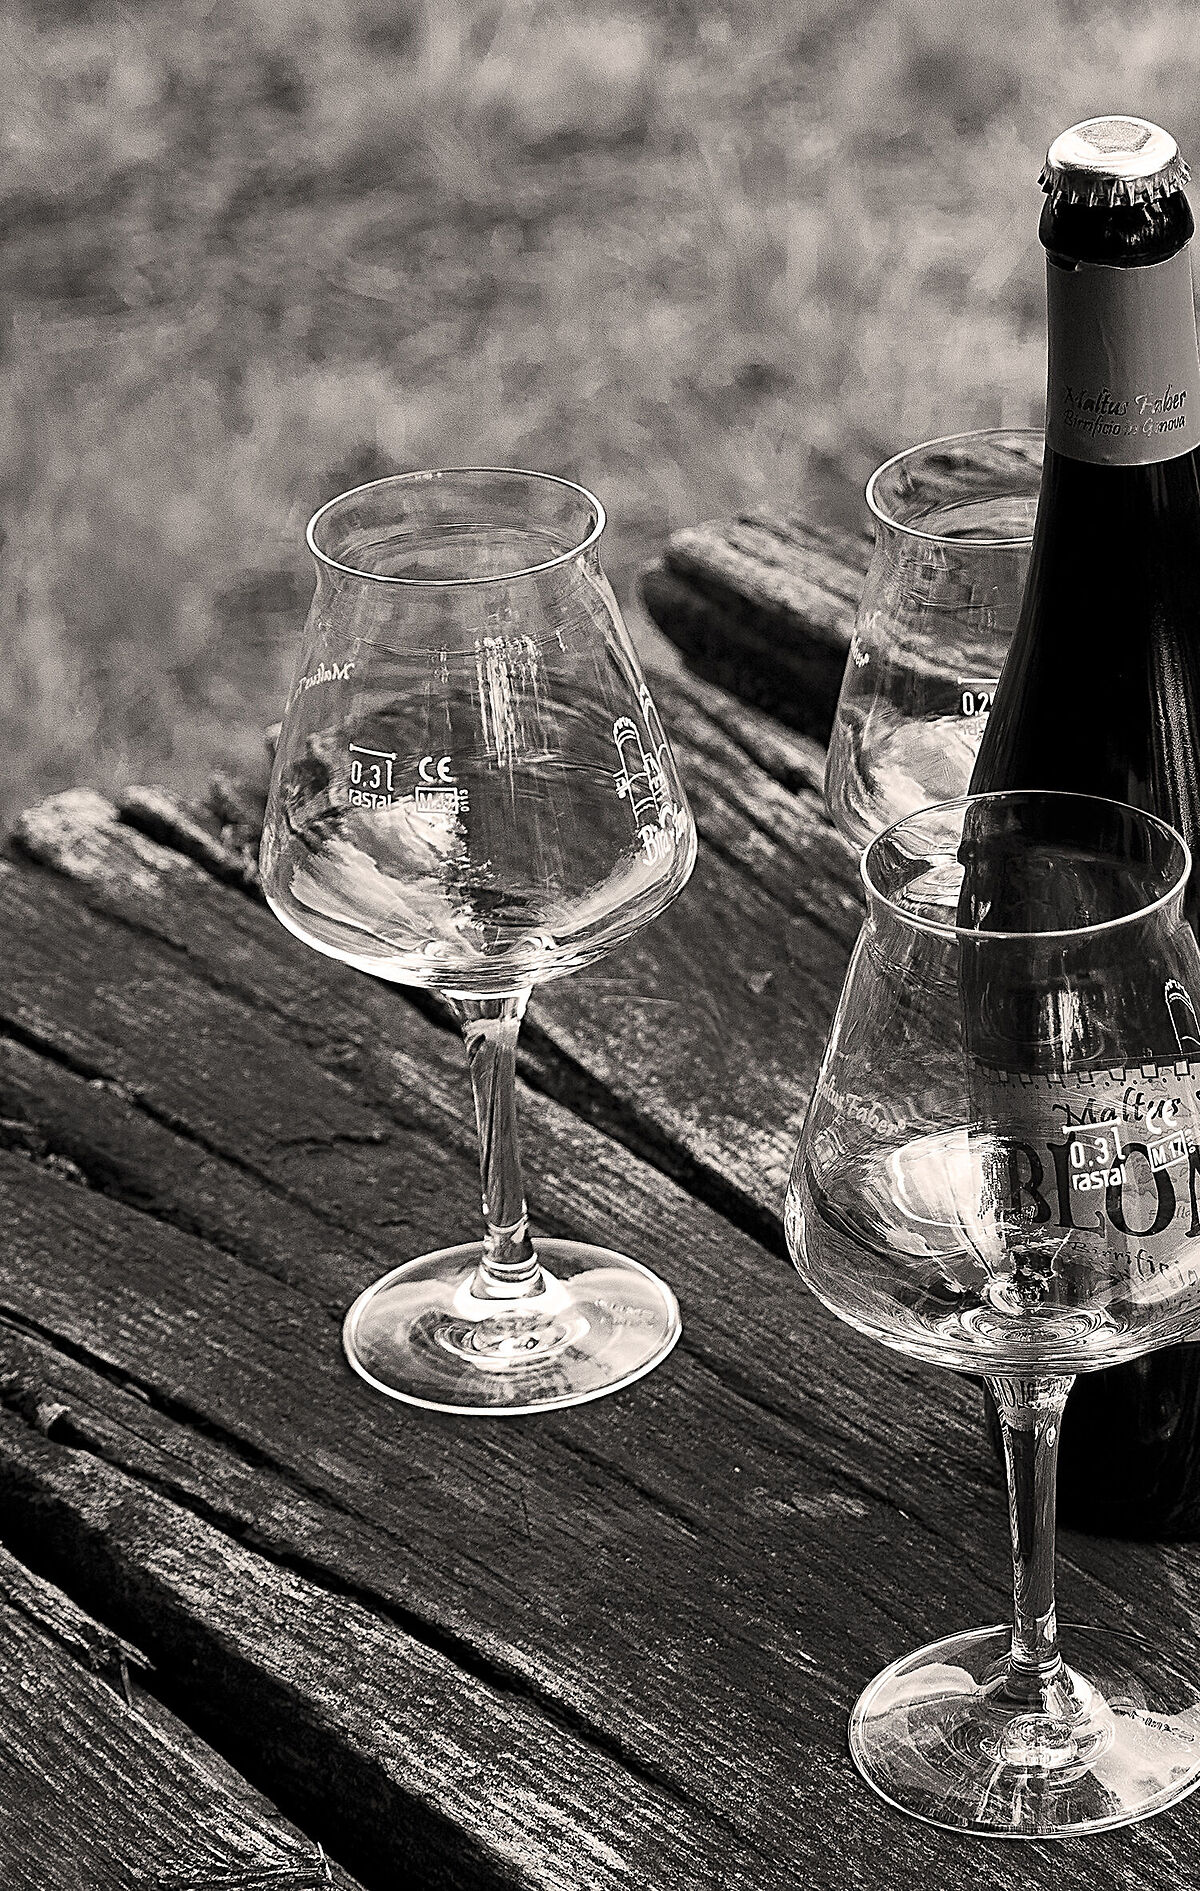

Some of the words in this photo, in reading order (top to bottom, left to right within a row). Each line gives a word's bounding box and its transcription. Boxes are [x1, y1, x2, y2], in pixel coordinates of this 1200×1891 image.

[1064, 386, 1129, 416] Maltus
[1135, 384, 1187, 415] Faber
[349, 789, 392, 810] rastal
[1052, 1086, 1181, 1127] Maltus
[1072, 1163, 1127, 1191] rastal
